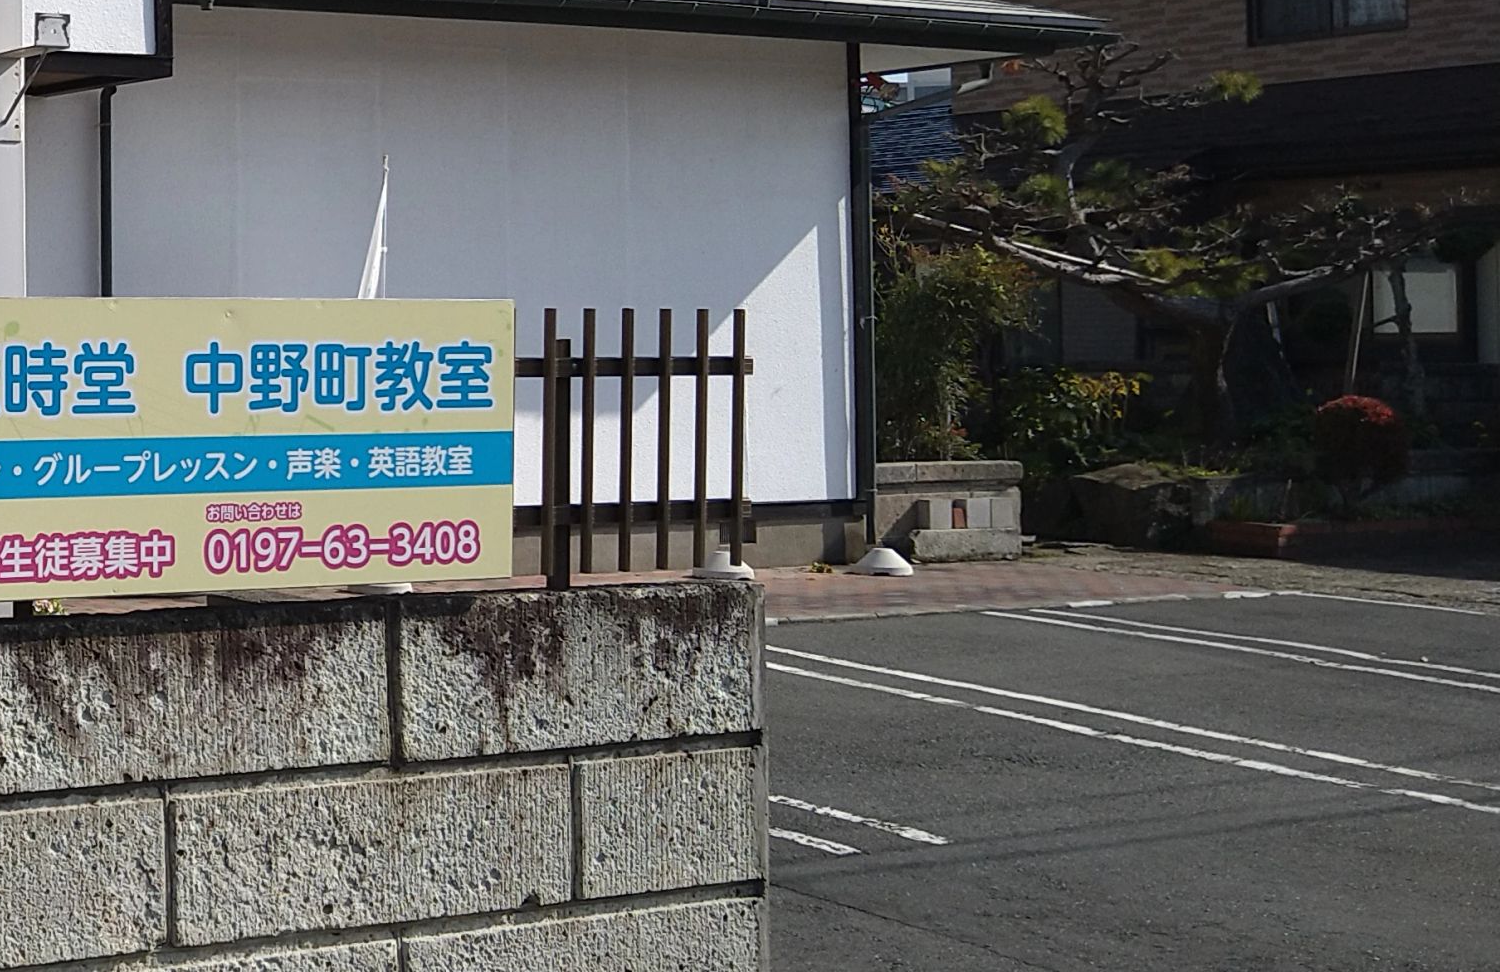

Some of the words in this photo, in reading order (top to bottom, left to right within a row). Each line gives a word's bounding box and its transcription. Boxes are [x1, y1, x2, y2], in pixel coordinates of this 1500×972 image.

[185, 339, 494, 415] 中野町教室
[206, 502, 302, 522] お問い合わせは
[205, 522, 480, 573] 0197-63-3408
